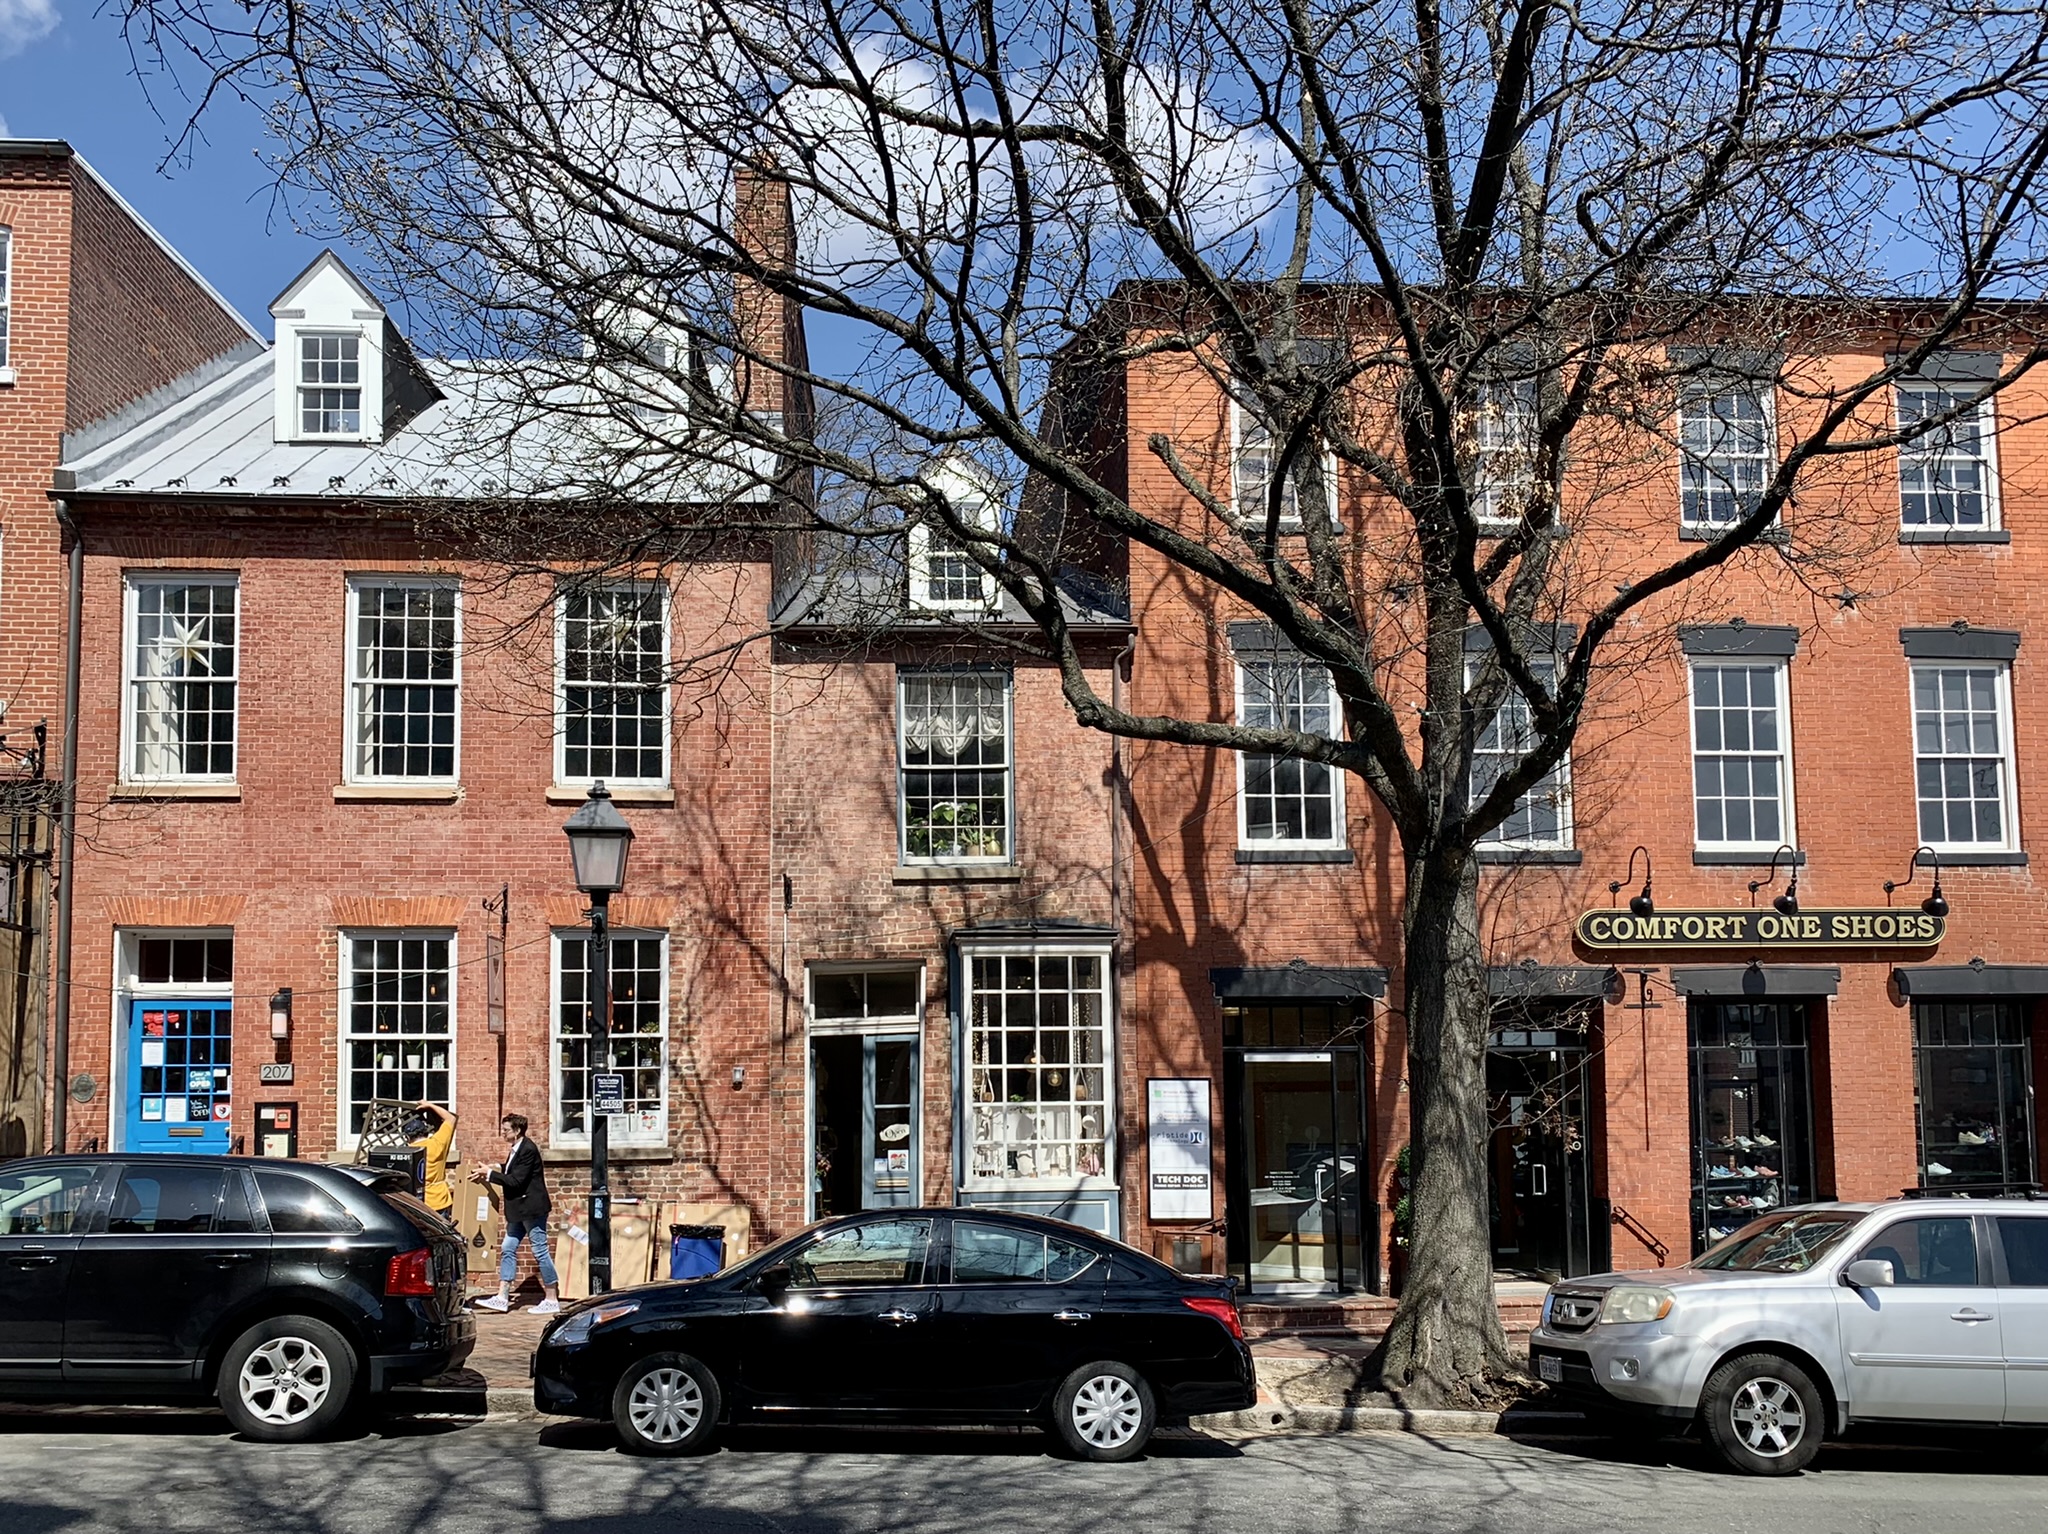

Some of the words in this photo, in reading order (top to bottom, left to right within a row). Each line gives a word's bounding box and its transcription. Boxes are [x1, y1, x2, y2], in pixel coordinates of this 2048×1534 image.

[1589, 915, 1748, 940] COMFORT
[1757, 915, 1822, 939] ONE
[1831, 914, 1936, 938] SHOES
[263, 1066, 289, 1078] 207
[601, 1100, 622, 1108] 44505
[884, 1128, 907, 1139] Open
[1156, 1131, 1189, 1139] riptide
[1156, 1175, 1182, 1184] TECH
[1183, 1175, 1204, 1184] DOC
